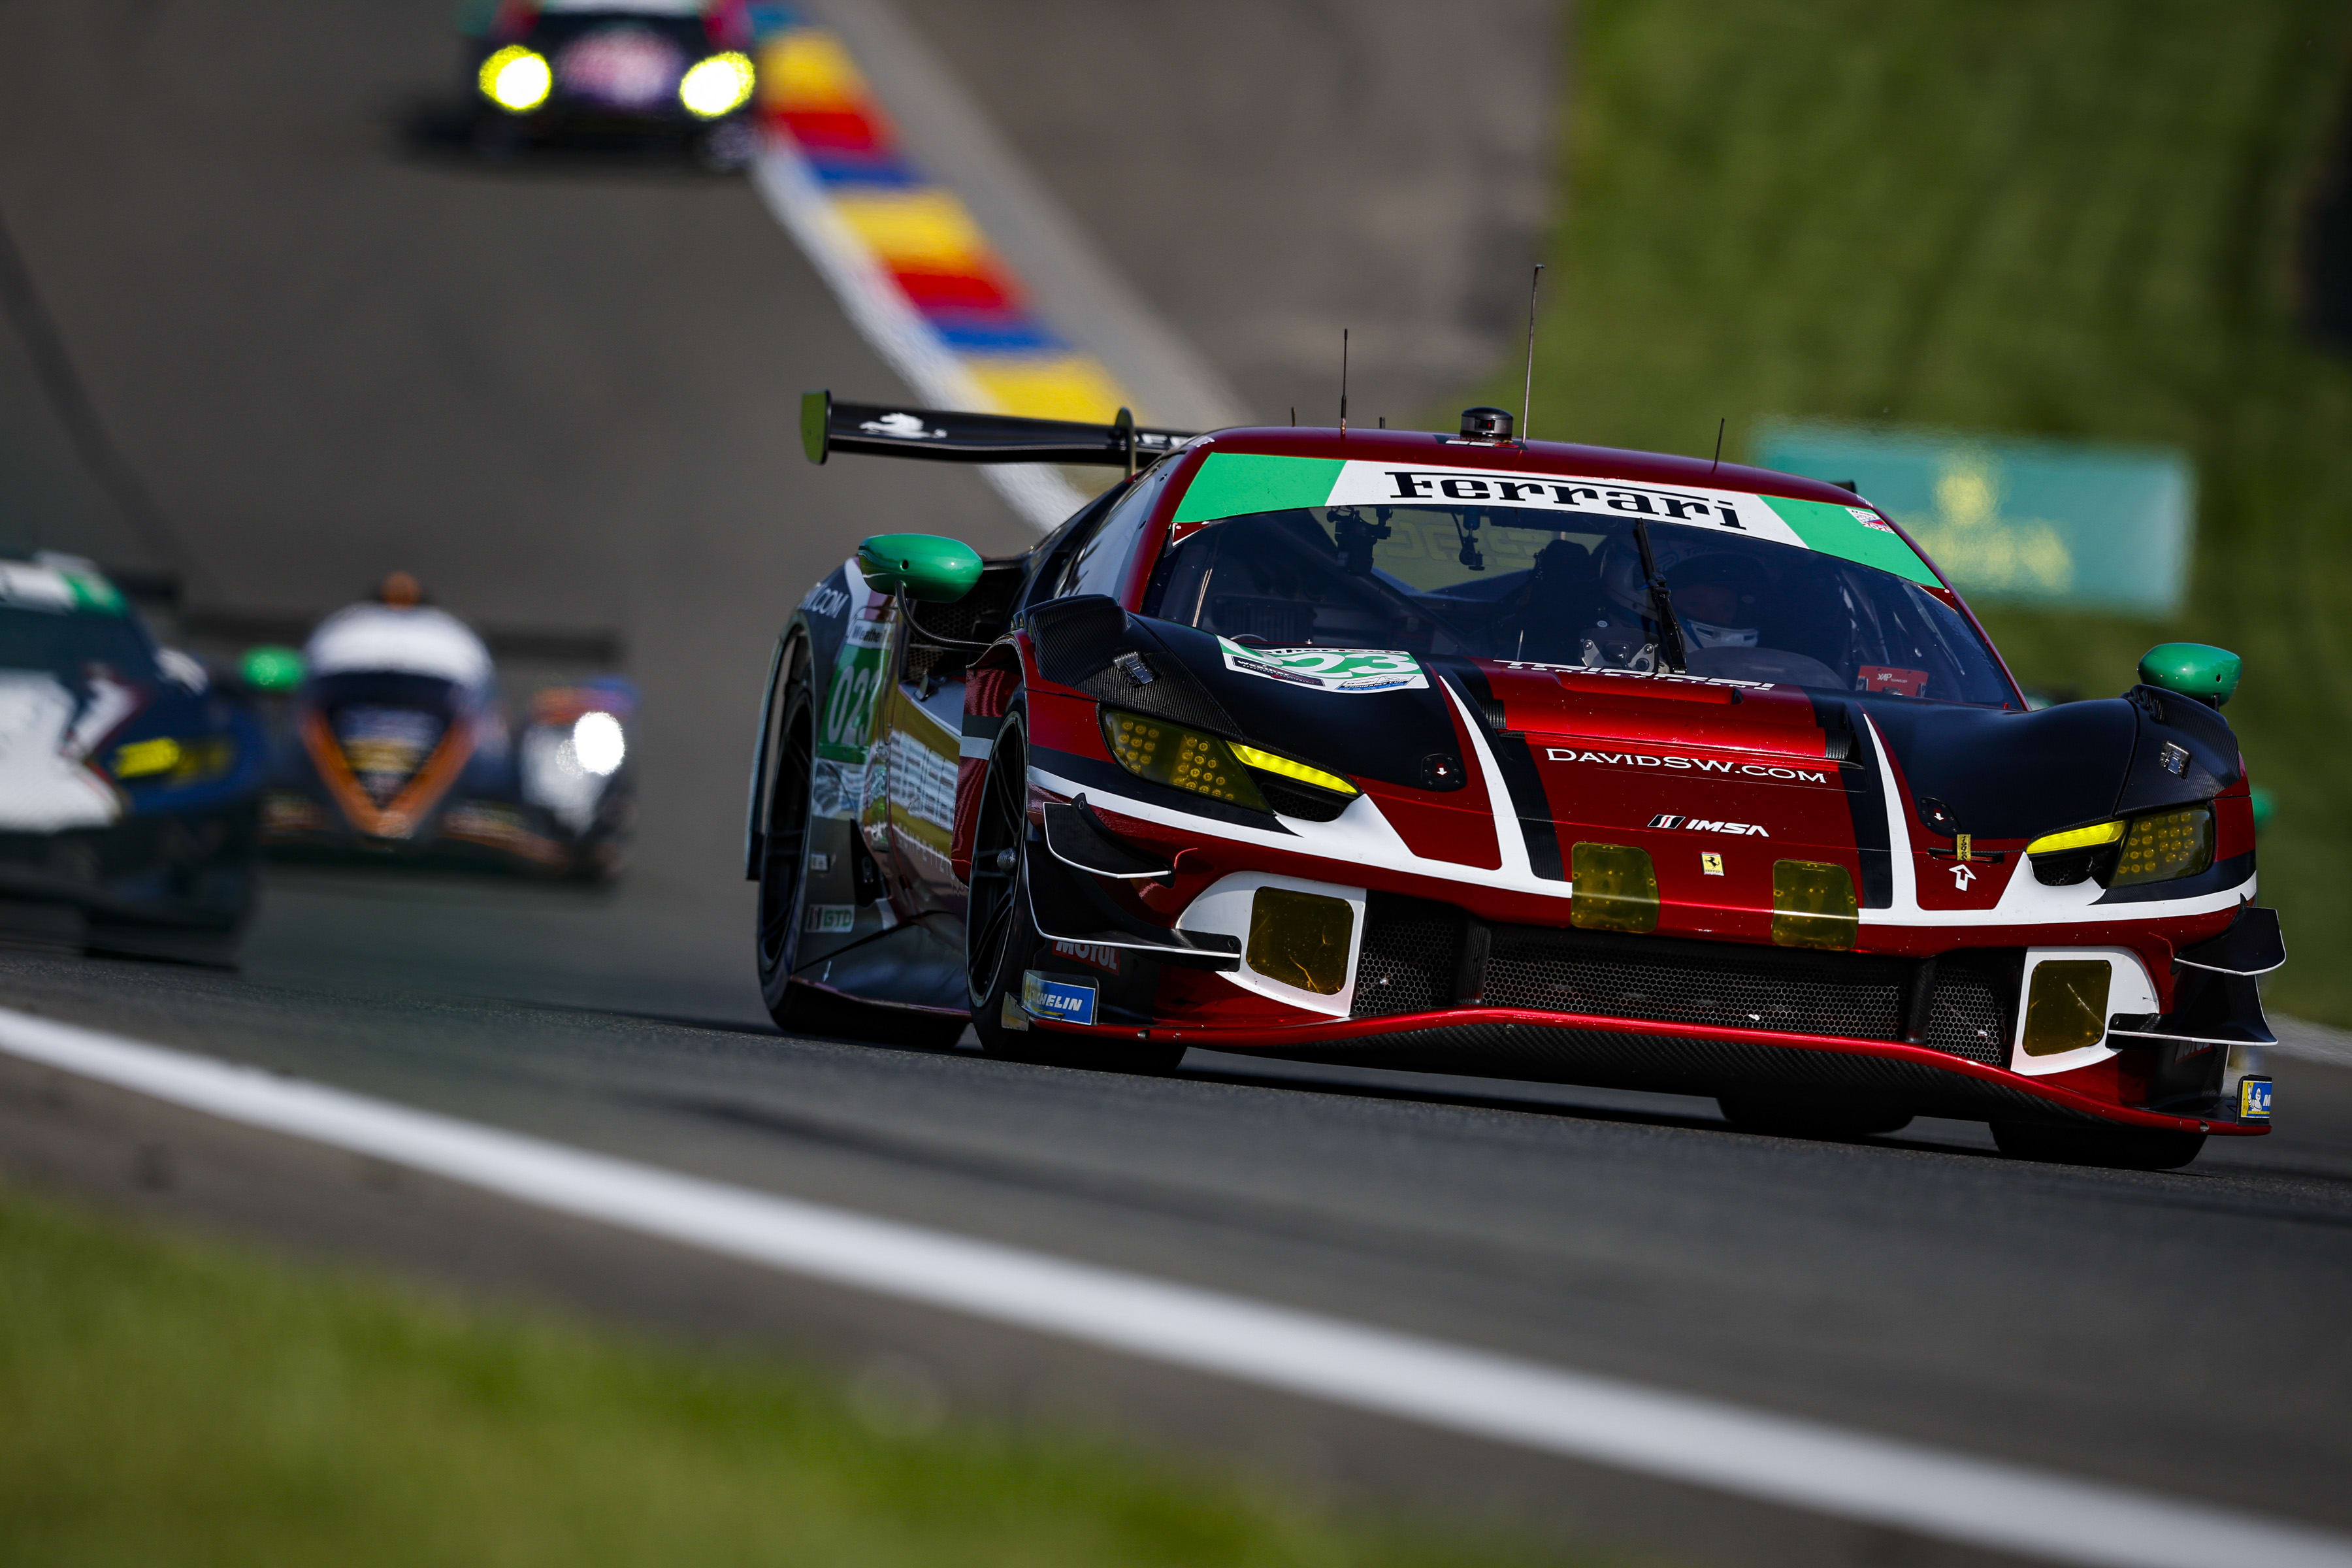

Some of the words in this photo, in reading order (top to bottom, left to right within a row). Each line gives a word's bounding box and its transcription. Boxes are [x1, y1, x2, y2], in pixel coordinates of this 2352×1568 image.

[1384, 471, 1747, 531] Ferrari
[1686, 819, 1770, 838] IMSA
[824, 910, 852, 926] GTD
